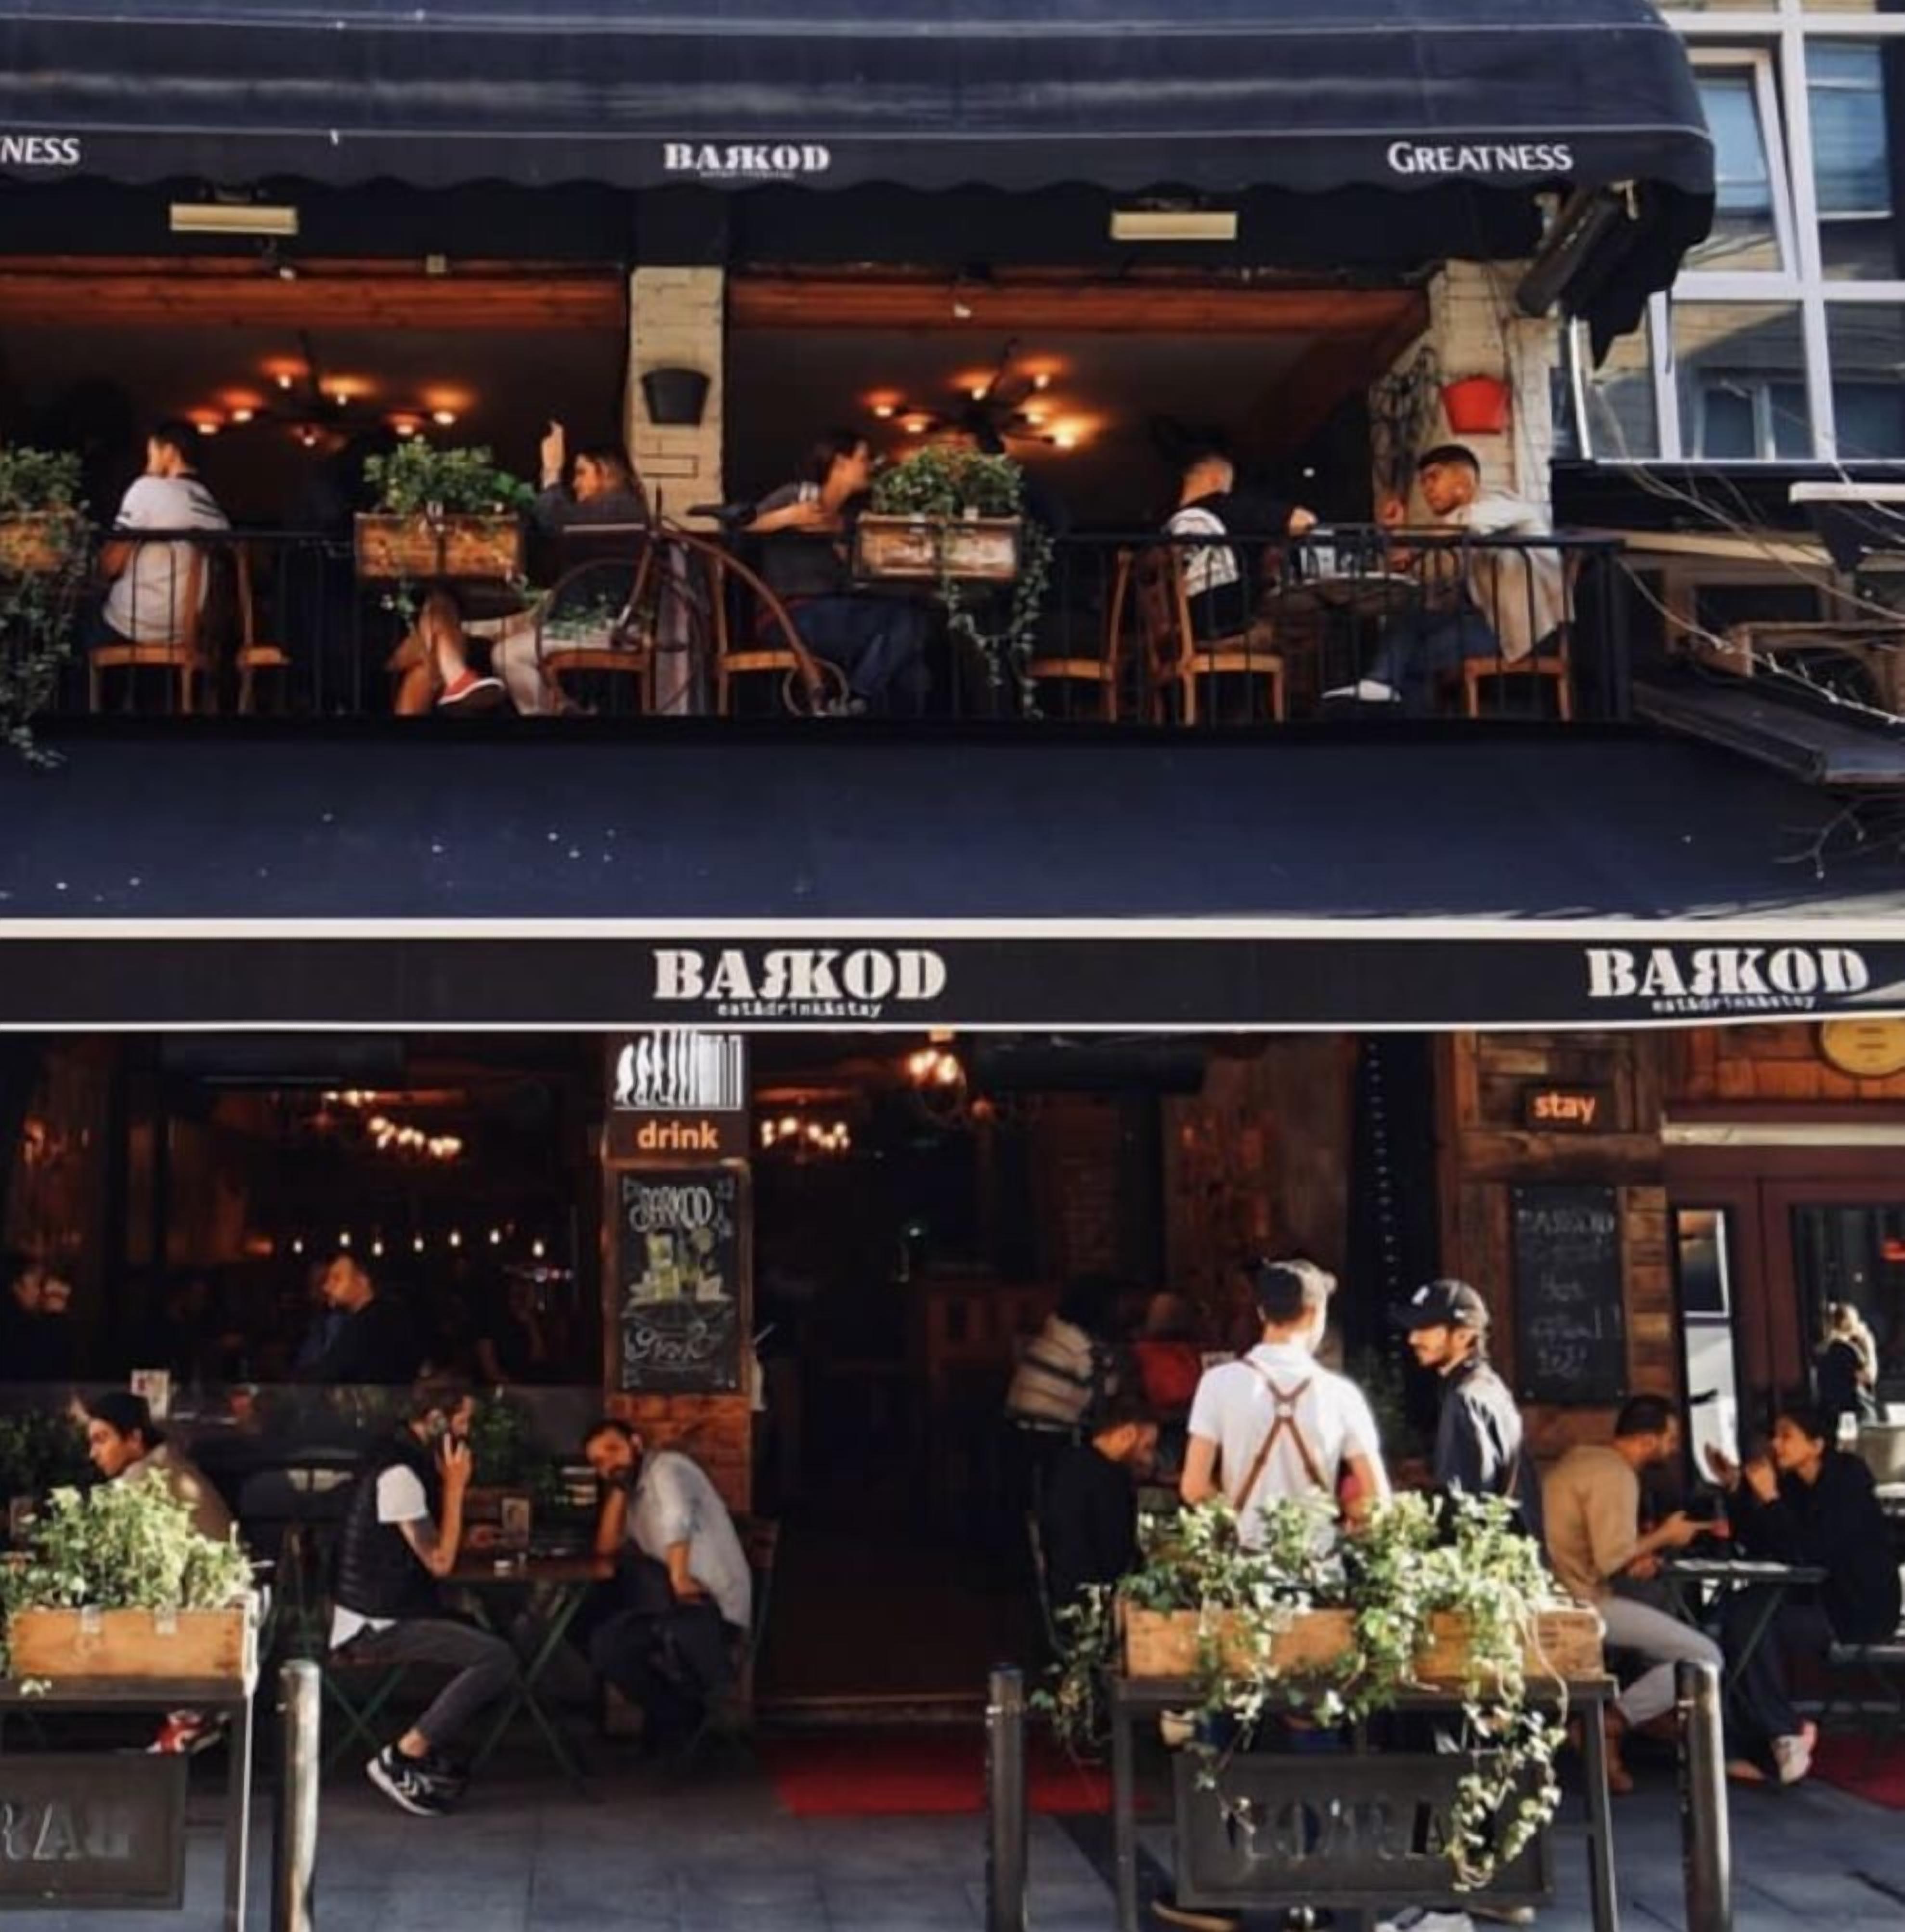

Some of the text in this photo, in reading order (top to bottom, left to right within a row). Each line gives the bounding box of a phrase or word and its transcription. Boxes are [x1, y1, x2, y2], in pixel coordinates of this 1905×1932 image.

[1387, 141, 1574, 173] GREATNESS
[1534, 1091, 1596, 1125] stay
[637, 1120, 719, 1149] drink
